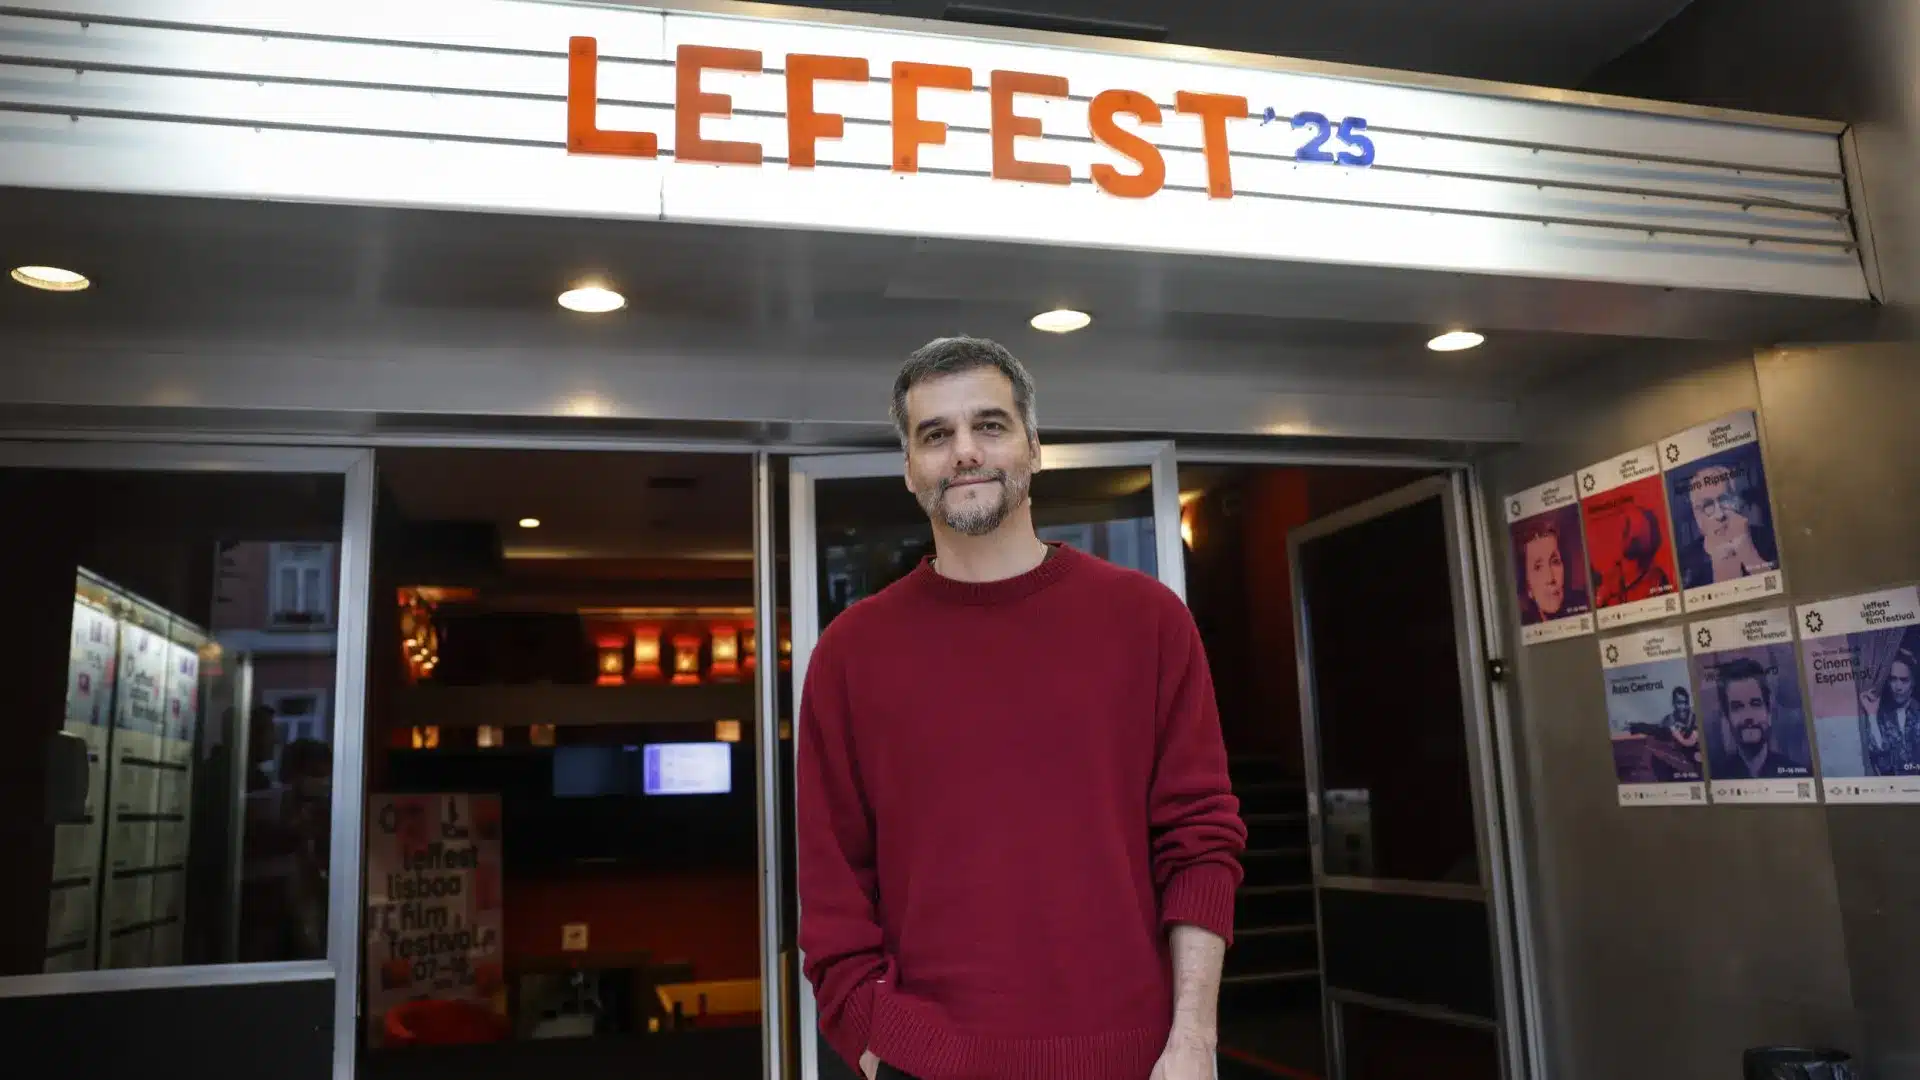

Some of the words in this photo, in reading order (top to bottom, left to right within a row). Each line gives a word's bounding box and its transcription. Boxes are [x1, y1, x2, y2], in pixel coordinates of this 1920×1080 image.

[1862, 600, 1891, 611] leffest
[1860, 609, 1886, 619] lisboa
[1866, 616, 1883, 625] film
[1882, 611, 1916, 624] festival
[1813, 656, 1861, 671] Cinema
[1815, 667, 1873, 686] Espanhol
[1630, 679, 1665, 693] Central
